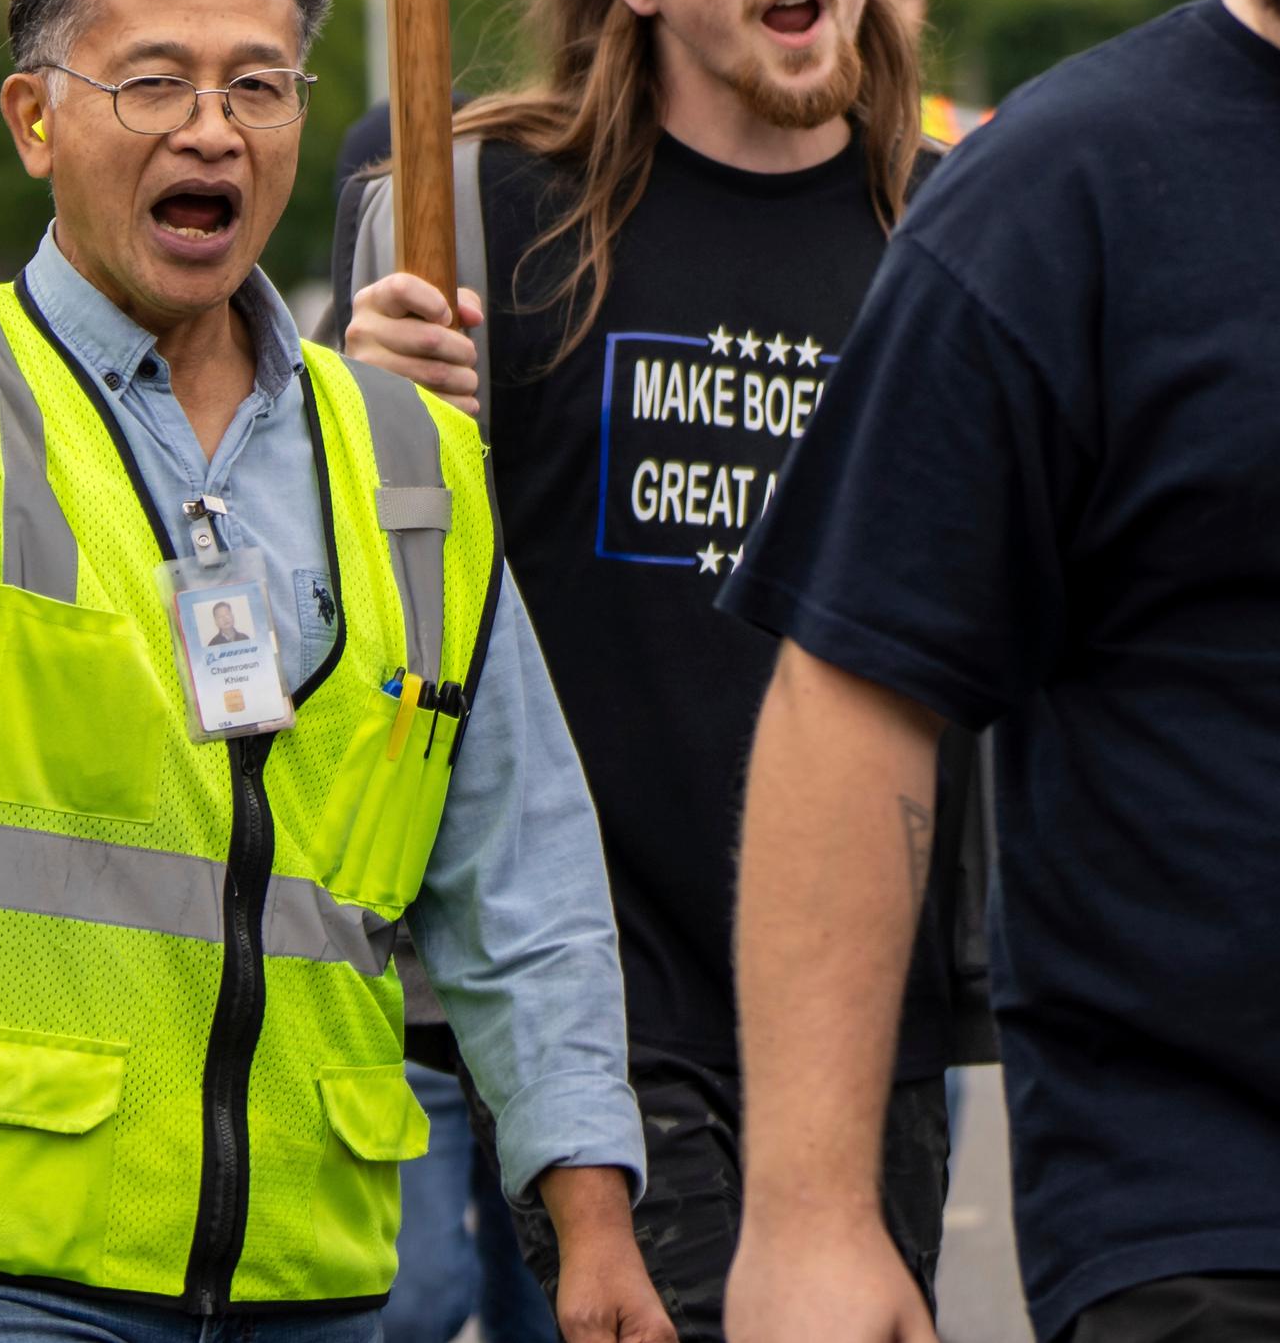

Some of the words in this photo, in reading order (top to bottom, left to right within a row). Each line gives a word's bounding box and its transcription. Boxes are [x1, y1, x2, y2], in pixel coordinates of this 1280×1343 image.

[632, 359, 736, 428] MAKE
[631, 459, 756, 529] GREAT
[218, 645, 259, 659] BOEING
[210, 660, 260, 675] Chamroeun
[223, 675, 250, 685] Khieu
[218, 720, 233, 728] USA
